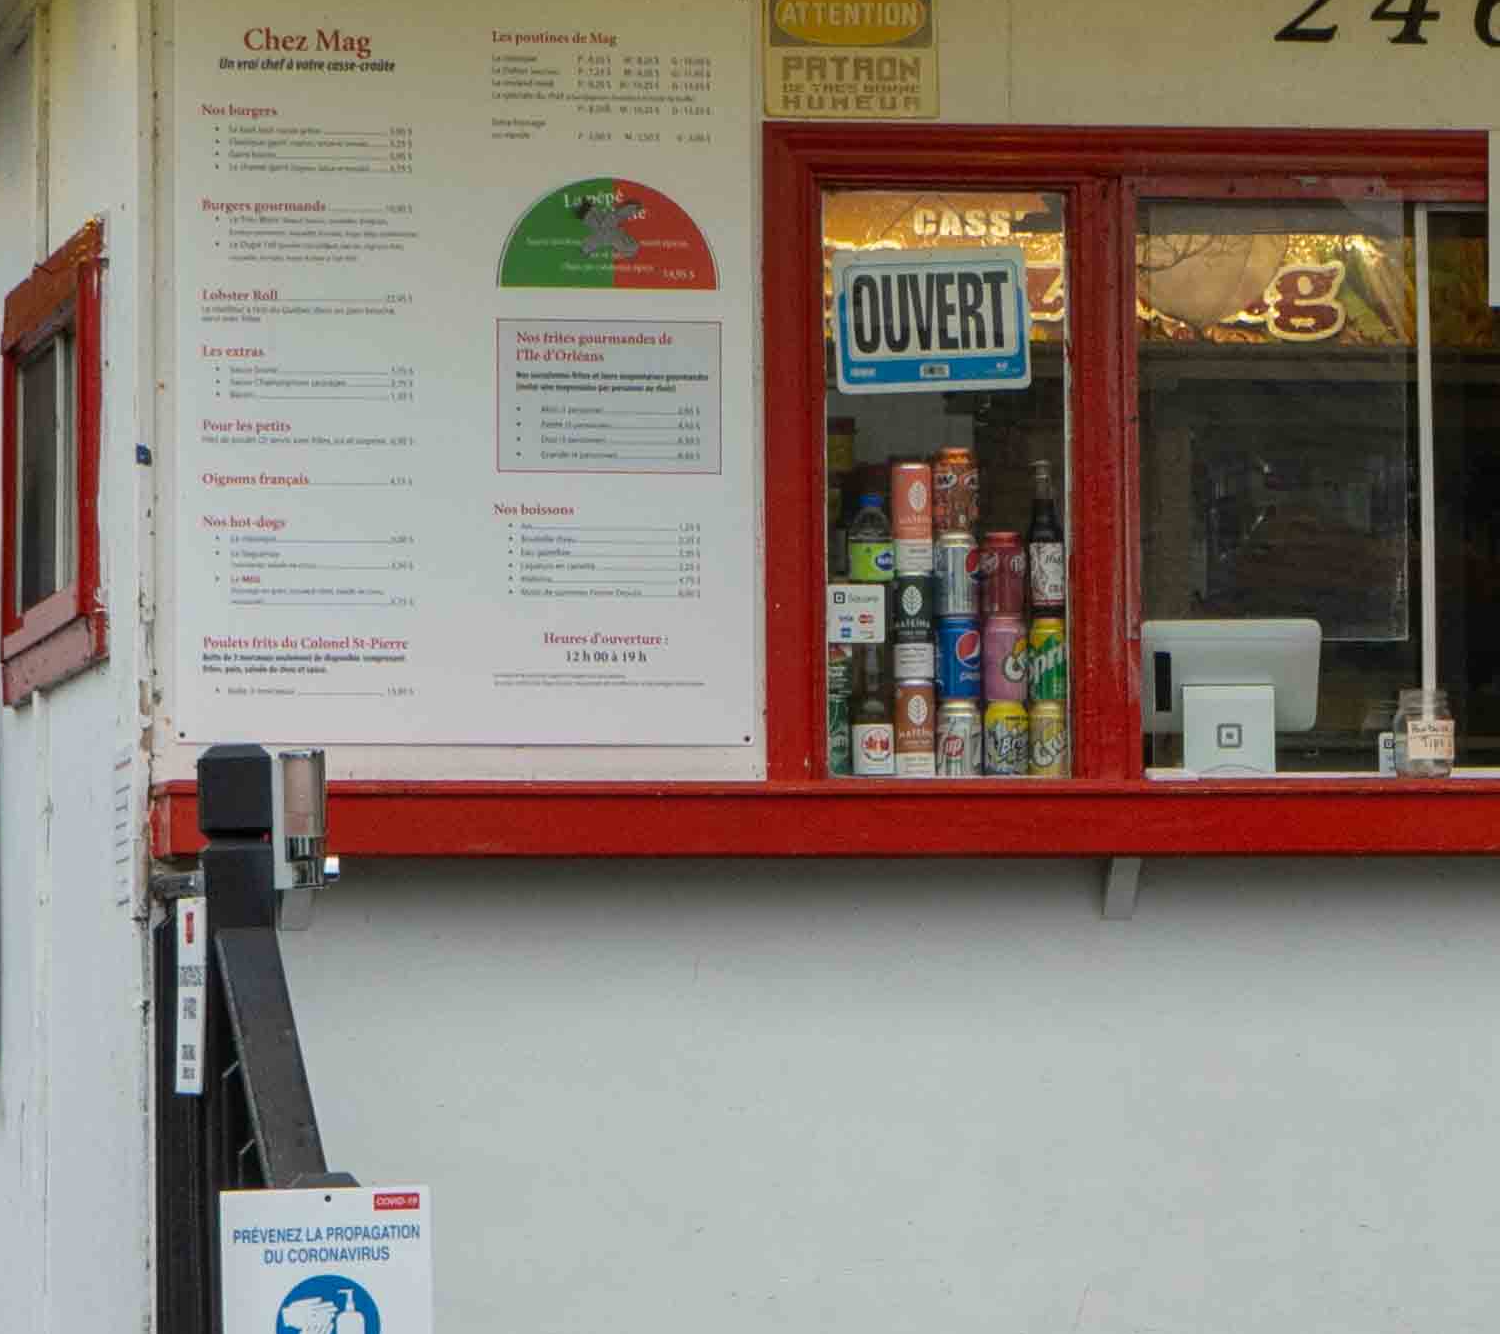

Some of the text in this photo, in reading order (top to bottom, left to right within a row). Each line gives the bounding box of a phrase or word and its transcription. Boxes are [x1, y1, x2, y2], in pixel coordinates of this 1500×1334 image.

[782, 0, 918, 27] ATTENTION
[244, 26, 373, 59] Chez Mag
[492, 31, 618, 47] Les poutines de Mag
[219, 57, 235, 69] Un
[237, 58, 260, 70] vrai
[261, 58, 286, 70] chef
[286, 58, 294, 70] à
[296, 59, 325, 71] votre
[781, 56, 921, 82] PATRON
[781, 95, 921, 110] HUMEUR
[201, 103, 278, 120] Nos burgers
[201, 199, 326, 216] Burgers gourmands
[202, 288, 250, 301] Lobster
[252, 288, 279, 301] Roll
[852, 270, 1009, 353] OUVERT
[516, 331, 673, 348] Nos frites gourmandes de
[202, 345, 265, 357] Les extras
[542, 349, 605, 362] d'Orléans
[202, 420, 292, 435] Pour les petits
[202, 473, 257, 487] Oignons
[259, 472, 310, 487] français
[494, 503, 575, 516] Nos boissons
[203, 516, 286, 531] Nos hot-dogs
[203, 635, 410, 651] Poulets frits du Colonel St-Pierre
[543, 632, 587, 645] Heures
[589, 632, 662, 645] d'ouverture
[565, 650, 647, 662] 12 h 00 à 19 h
[233, 1223, 420, 1244] PRÉVENEZ LA PROPAGATION
[264, 1245, 390, 1265] DU CORONAVIRUS
